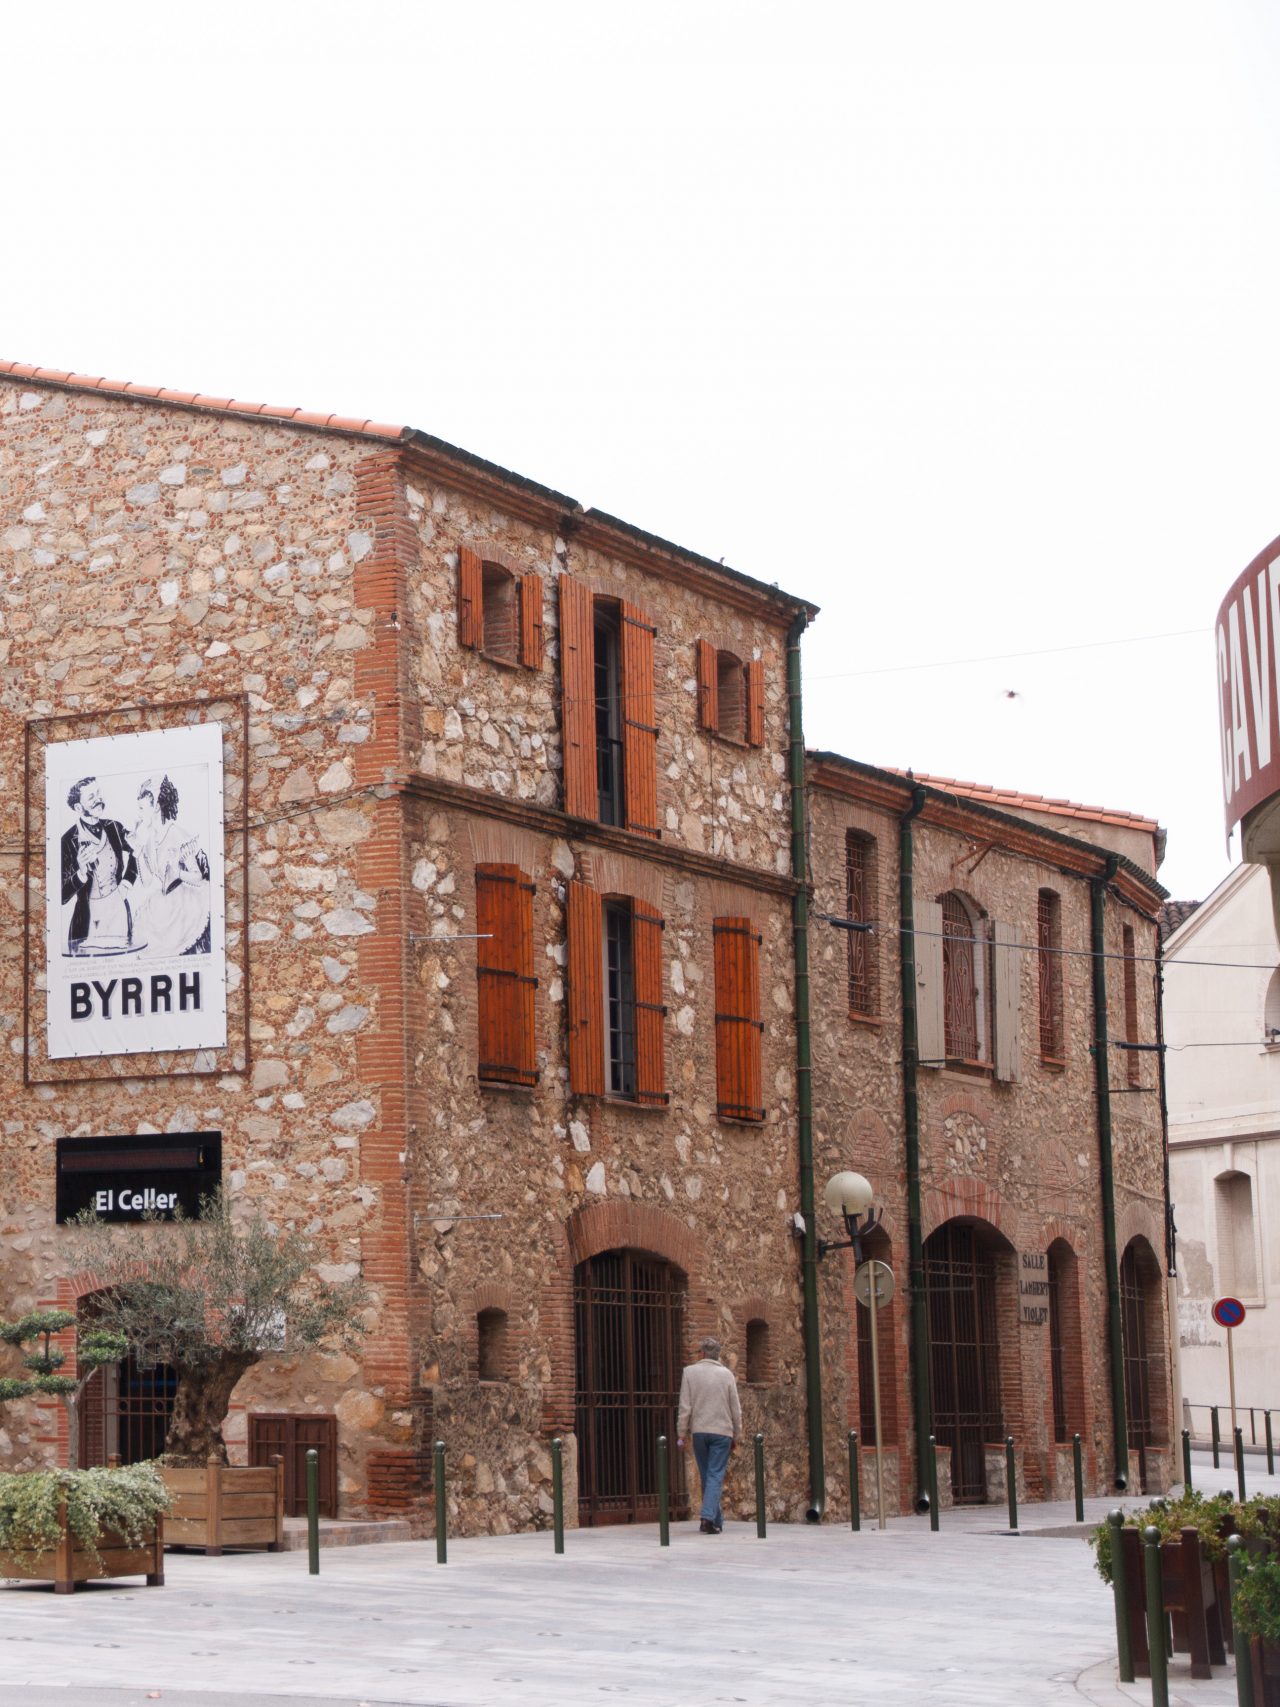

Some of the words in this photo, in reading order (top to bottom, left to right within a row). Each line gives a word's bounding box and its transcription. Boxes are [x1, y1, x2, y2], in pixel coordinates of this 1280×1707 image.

[70, 971, 202, 1021] BYRRH
[96, 1189, 113, 1211] El
[119, 1188, 177, 1210] Celler
[1022, 1254, 1044, 1269] SALLE
[1020, 1281, 1049, 1296] LAMBERT
[1023, 1306, 1048, 1322] VIOLET
